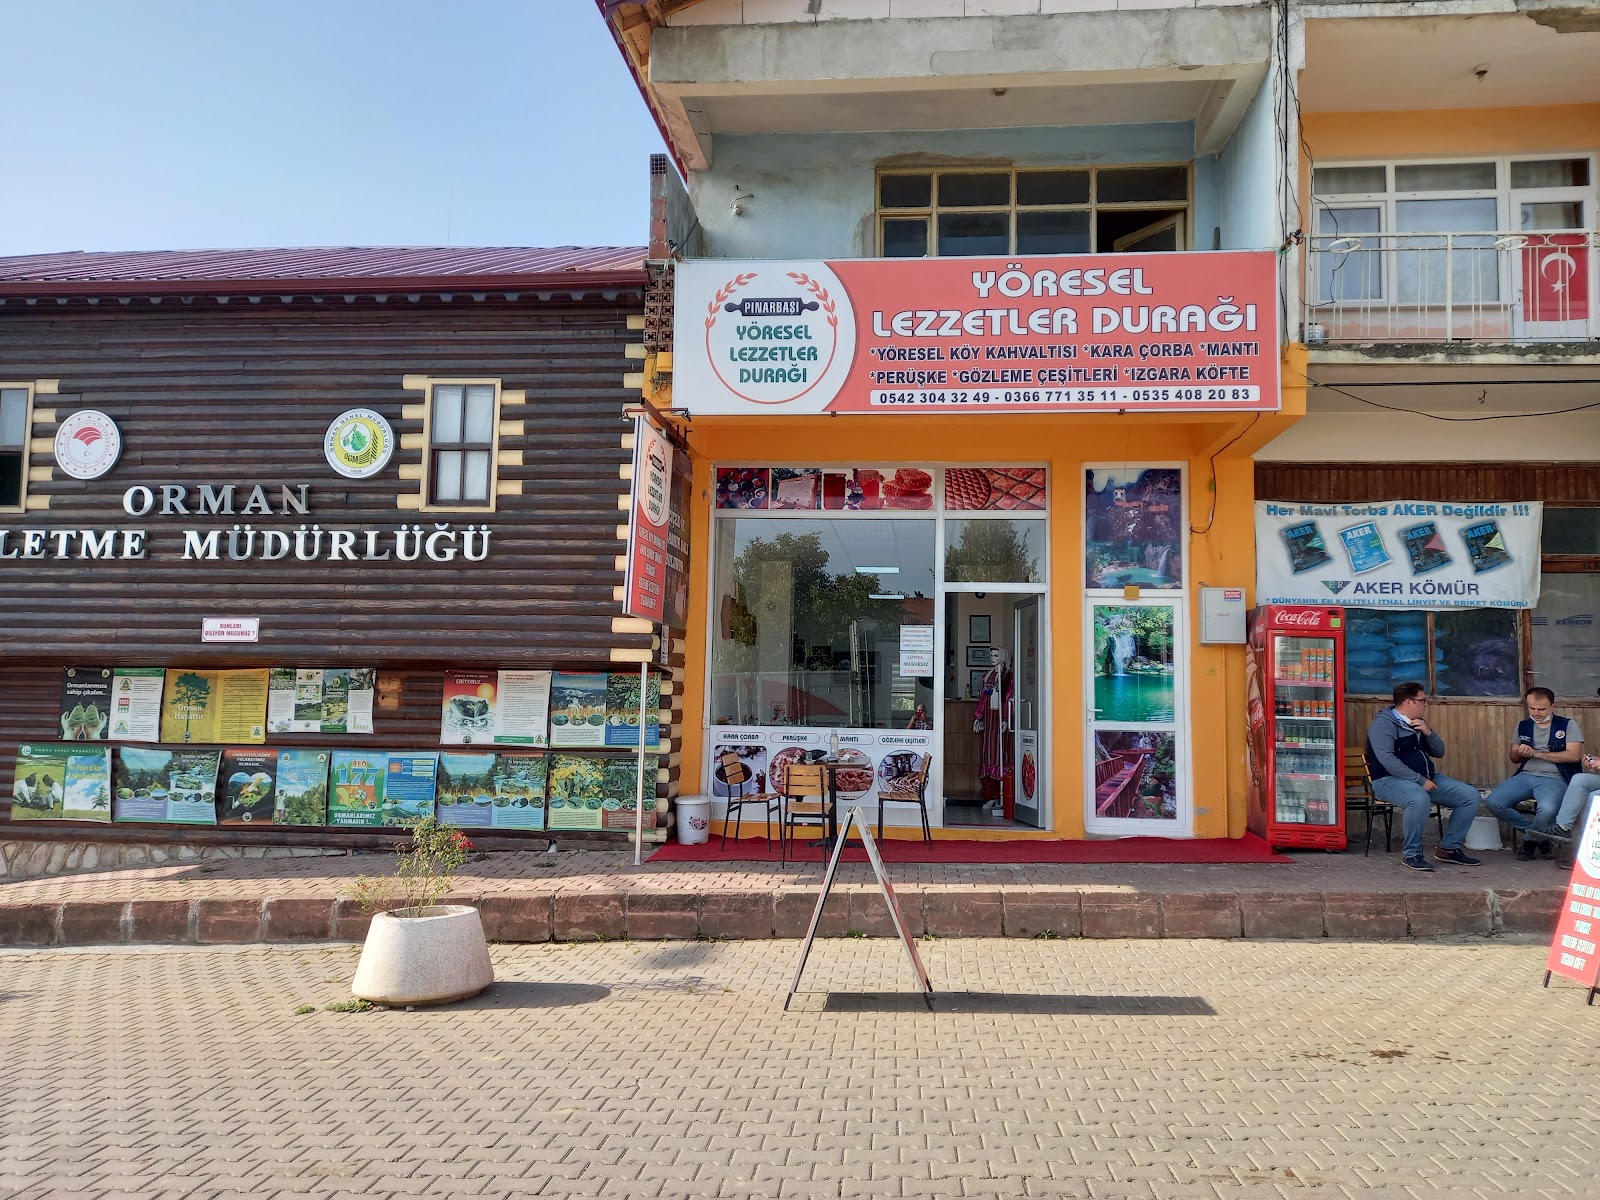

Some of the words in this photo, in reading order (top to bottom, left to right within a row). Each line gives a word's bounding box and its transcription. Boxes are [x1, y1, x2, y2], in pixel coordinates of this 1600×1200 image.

[972, 262, 1153, 298] YÖRESEL
[744, 301, 799, 315] PINARBAŞI
[872, 306, 1078, 337] LEZZETLER
[1092, 295, 1257, 334] DURAĞI
[736, 321, 812, 340] YÖRESEL
[729, 346, 818, 362] LEZZETLER
[950, 345, 981, 360] KÖY
[986, 345, 1078, 360] KAHVALTISI
[1139, 344, 1194, 361] ÇORBA
[739, 363, 807, 383] DURAĞI
[1037, 365, 1118, 386] ÇEŞİTLERİ
[1196, 364, 1250, 380] KÖFTE
[879, 392, 915, 403] 0542
[920, 392, 946, 403] 304
[951, 392, 968, 403] 32
[973, 392, 990, 403] 49
[1004, 391, 1040, 402] 0366
[1045, 391, 1071, 402] 771
[1077, 390, 1095, 401] 35
[1101, 390, 1117, 401] 11
[1132, 390, 1169, 401] 0535
[1175, 389, 1203, 400] 408
[1208, 389, 1226, 400] 20
[1232, 388, 1250, 399] 83
[122, 484, 310, 516] ORMAN
[1266, 504, 1295, 516] Her
[1299, 505, 1338, 516] Mavi
[1342, 505, 1387, 516] Torba
[1392, 504, 1438, 516] AKER
[1442, 504, 1507, 519] Değildir
[1512, 505, 1530, 516] !!!
[1287, 525, 1313, 539] AKER
[1347, 526, 1372, 540] AKER
[1406, 526, 1432, 540] AKER
[1467, 524, 1493, 539] AKER
[0, 529, 146, 560] LETME
[180, 522, 492, 562] MÜDÜRLÜĞÜ
[1353, 582, 1404, 595] AKER
[1409, 580, 1480, 596] KÖMÜR
[1272, 596, 1319, 604] DÜNYANIN
[1378, 597, 1405, 605] İTHAL
[782, 734, 808, 742] PERÜŞKE
[335, 766, 380, 786] 177
